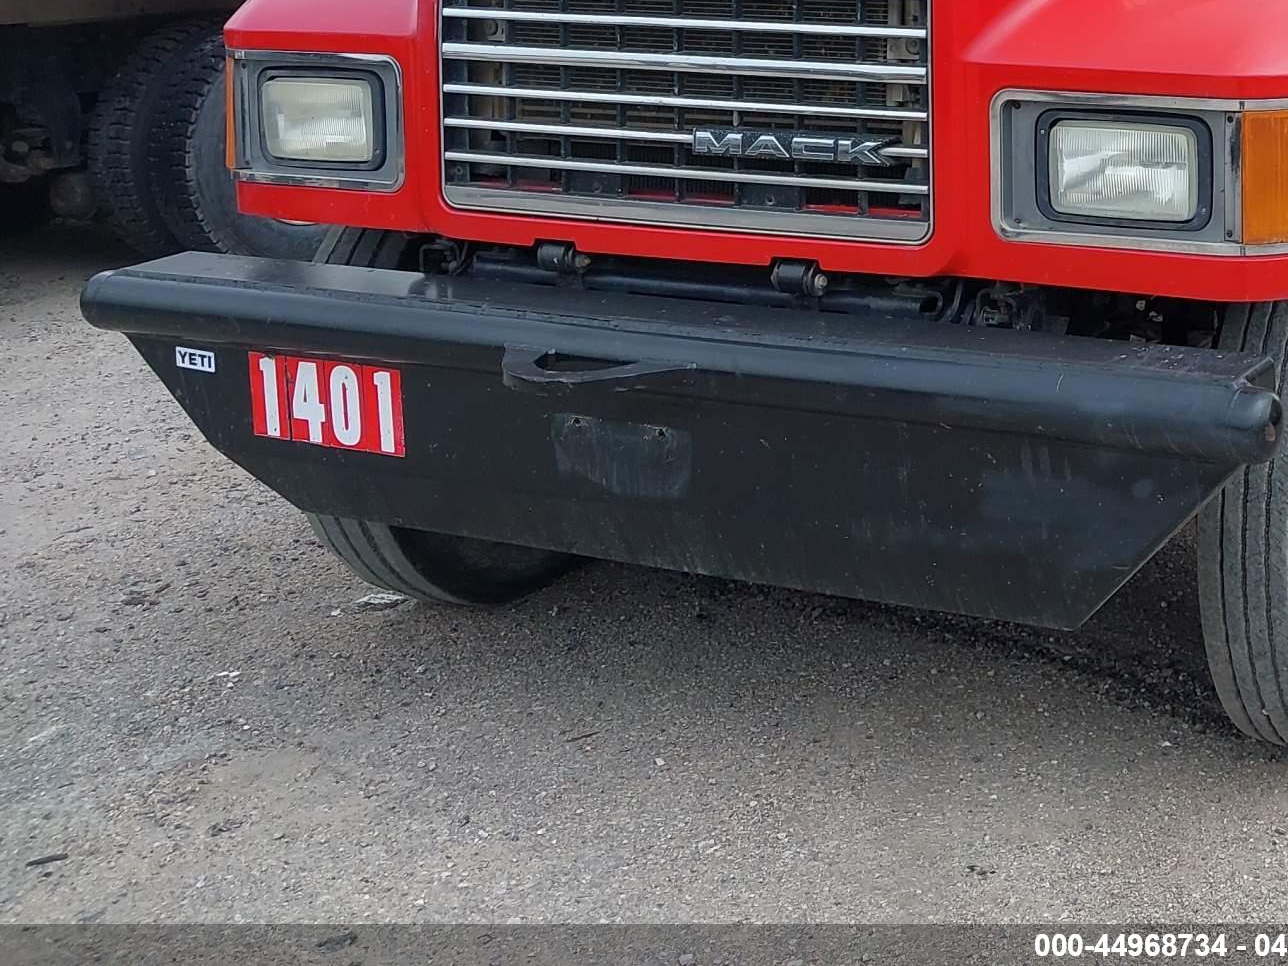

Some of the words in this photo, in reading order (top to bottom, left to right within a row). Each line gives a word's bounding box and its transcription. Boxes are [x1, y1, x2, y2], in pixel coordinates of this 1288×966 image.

[694, 130, 886, 165] MACK
[177, 349, 213, 371] YETI
[258, 356, 395, 453] 1401
